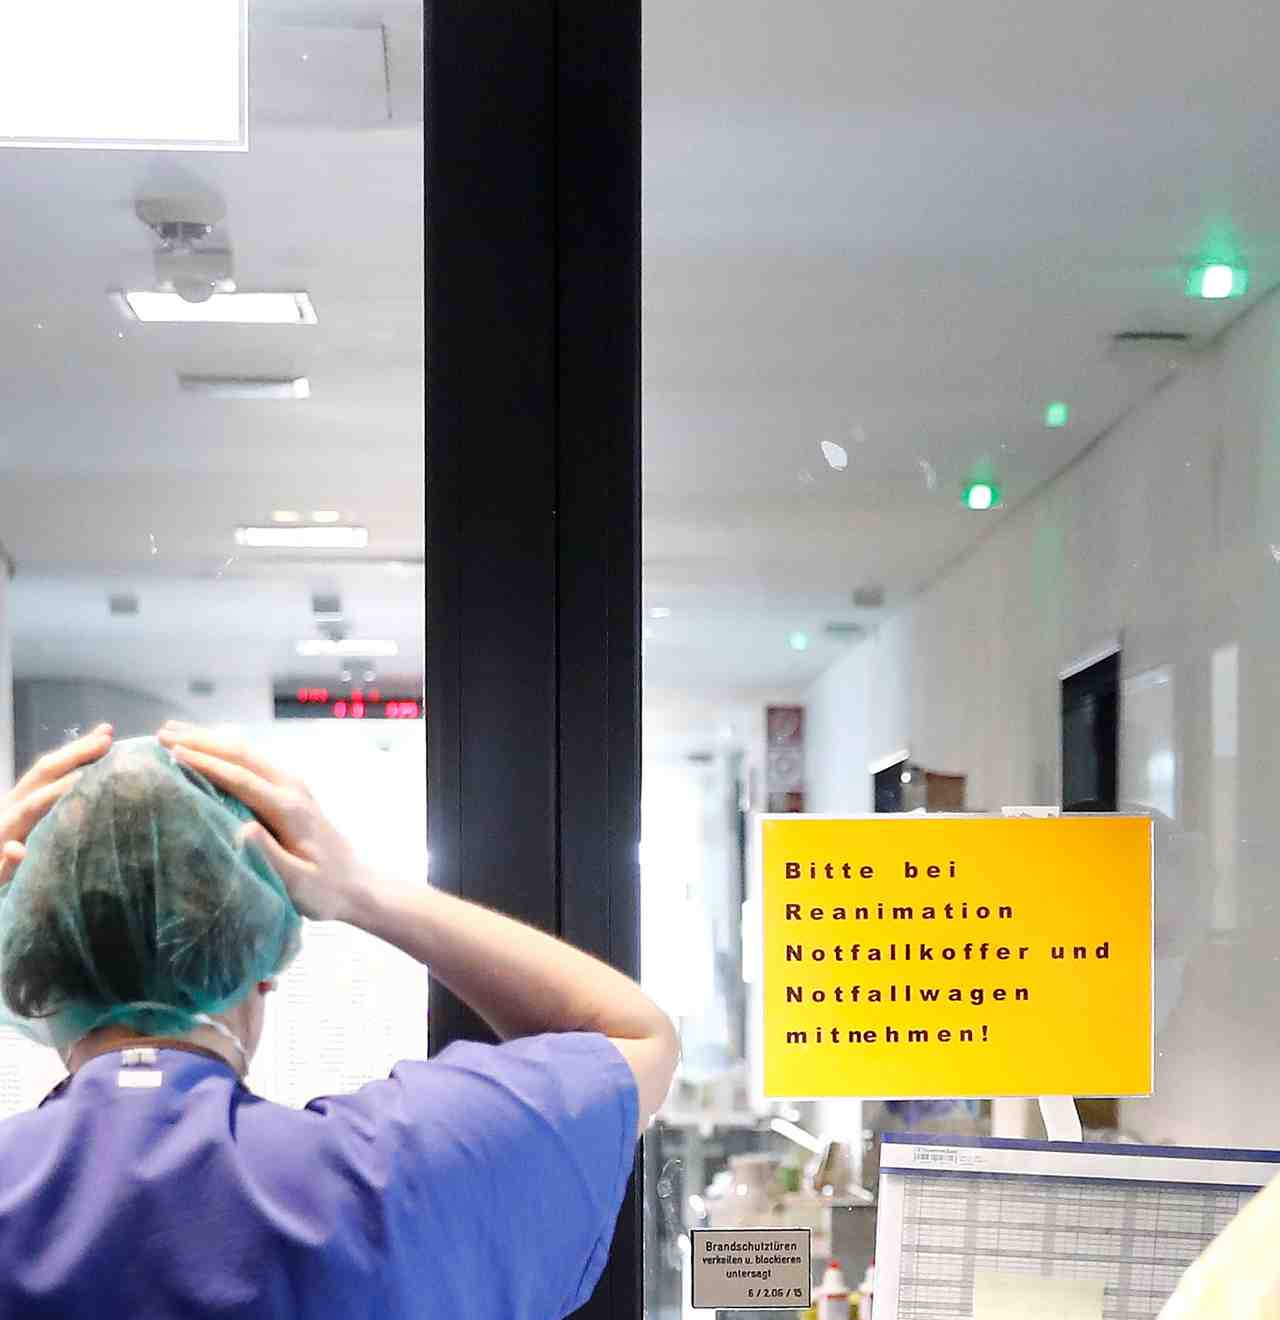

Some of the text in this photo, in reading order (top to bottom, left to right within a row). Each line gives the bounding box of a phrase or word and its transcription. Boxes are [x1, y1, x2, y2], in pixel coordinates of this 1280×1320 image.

[785, 860, 955, 880] Bitte bei
[785, 902, 1013, 921] Reanimation
[786, 941, 1109, 962] Notfallkoffer und
[786, 984, 1029, 1006] Notfallwagen
[786, 1024, 988, 1044] mitnehmen!
[705, 1240, 797, 1252] Brandschutztüren
[702, 1254, 802, 1265] verkeilen u. blockieren
[725, 1269, 772, 1281] untersagt
